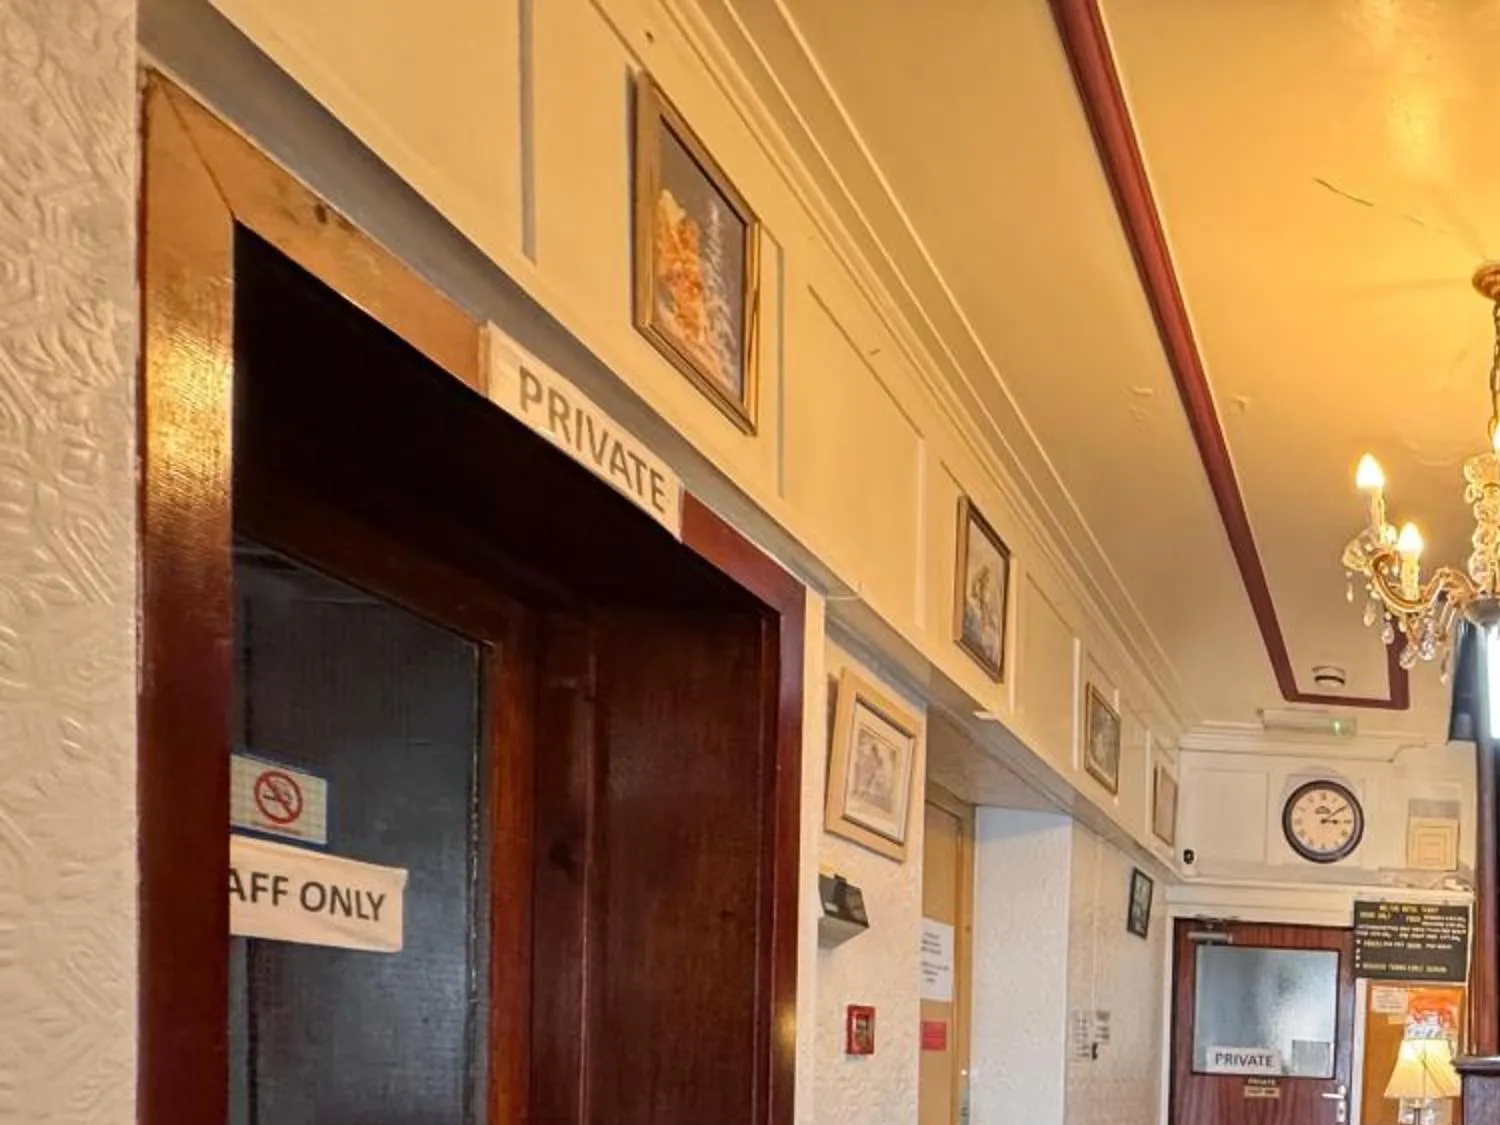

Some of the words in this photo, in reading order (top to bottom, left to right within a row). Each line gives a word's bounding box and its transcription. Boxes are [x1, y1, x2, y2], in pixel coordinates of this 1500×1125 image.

[518, 364, 668, 515] PRIVATE
[229, 868, 289, 907] AFF
[300, 881, 386, 922] ONLY
[1214, 1052, 1274, 1068] PRIVATE
